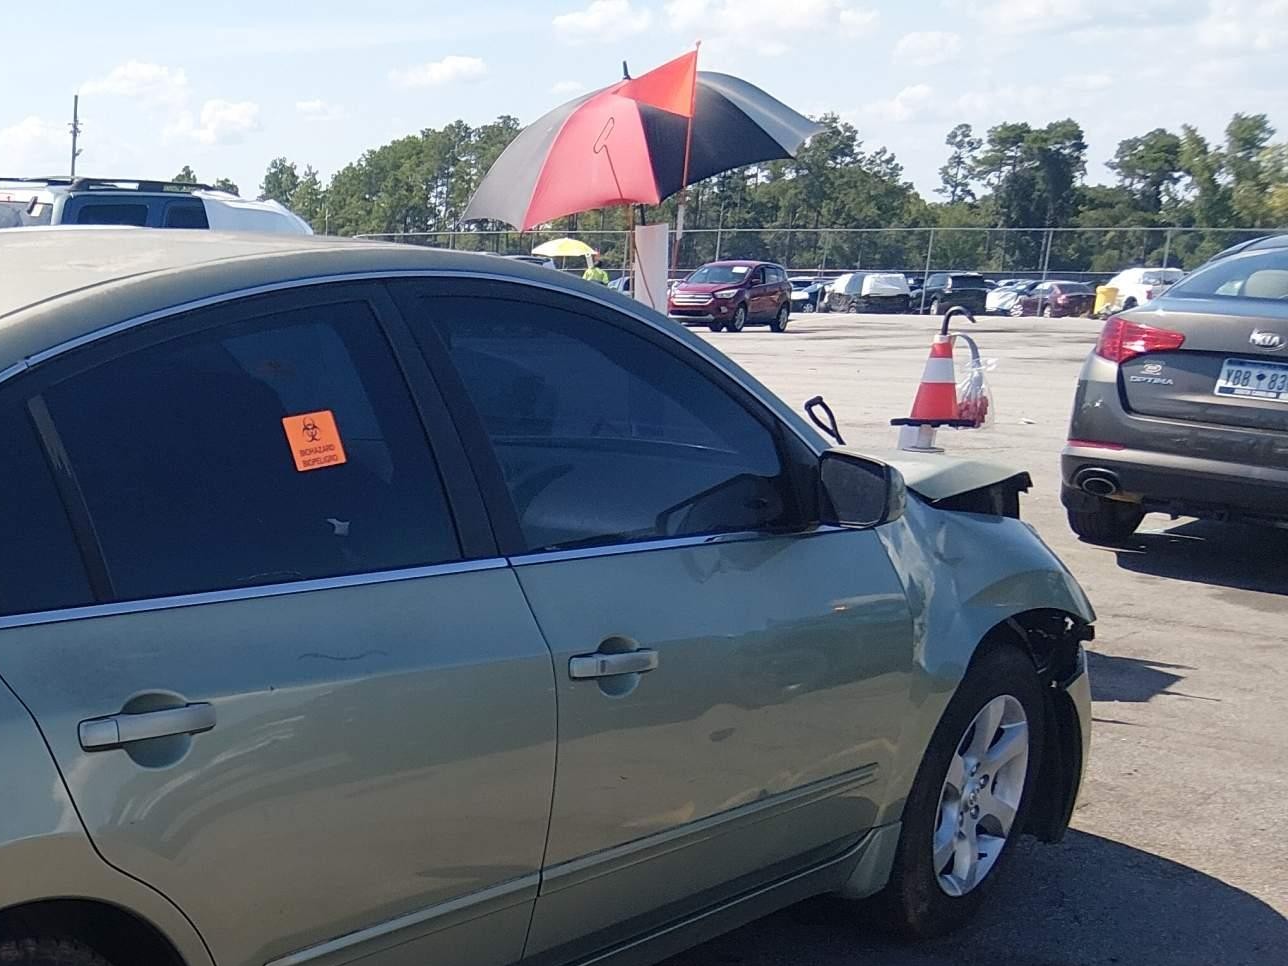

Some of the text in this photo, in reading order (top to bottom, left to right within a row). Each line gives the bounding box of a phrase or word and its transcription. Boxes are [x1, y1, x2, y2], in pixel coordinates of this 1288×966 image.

[1255, 335, 1280, 346] KIA
[1129, 375, 1174, 385] OPTIMA
[1268, 373, 1288, 391] 83
[299, 444, 336, 457] BIOHAZARD
[302, 454, 338, 467] BIOPELIGRO
